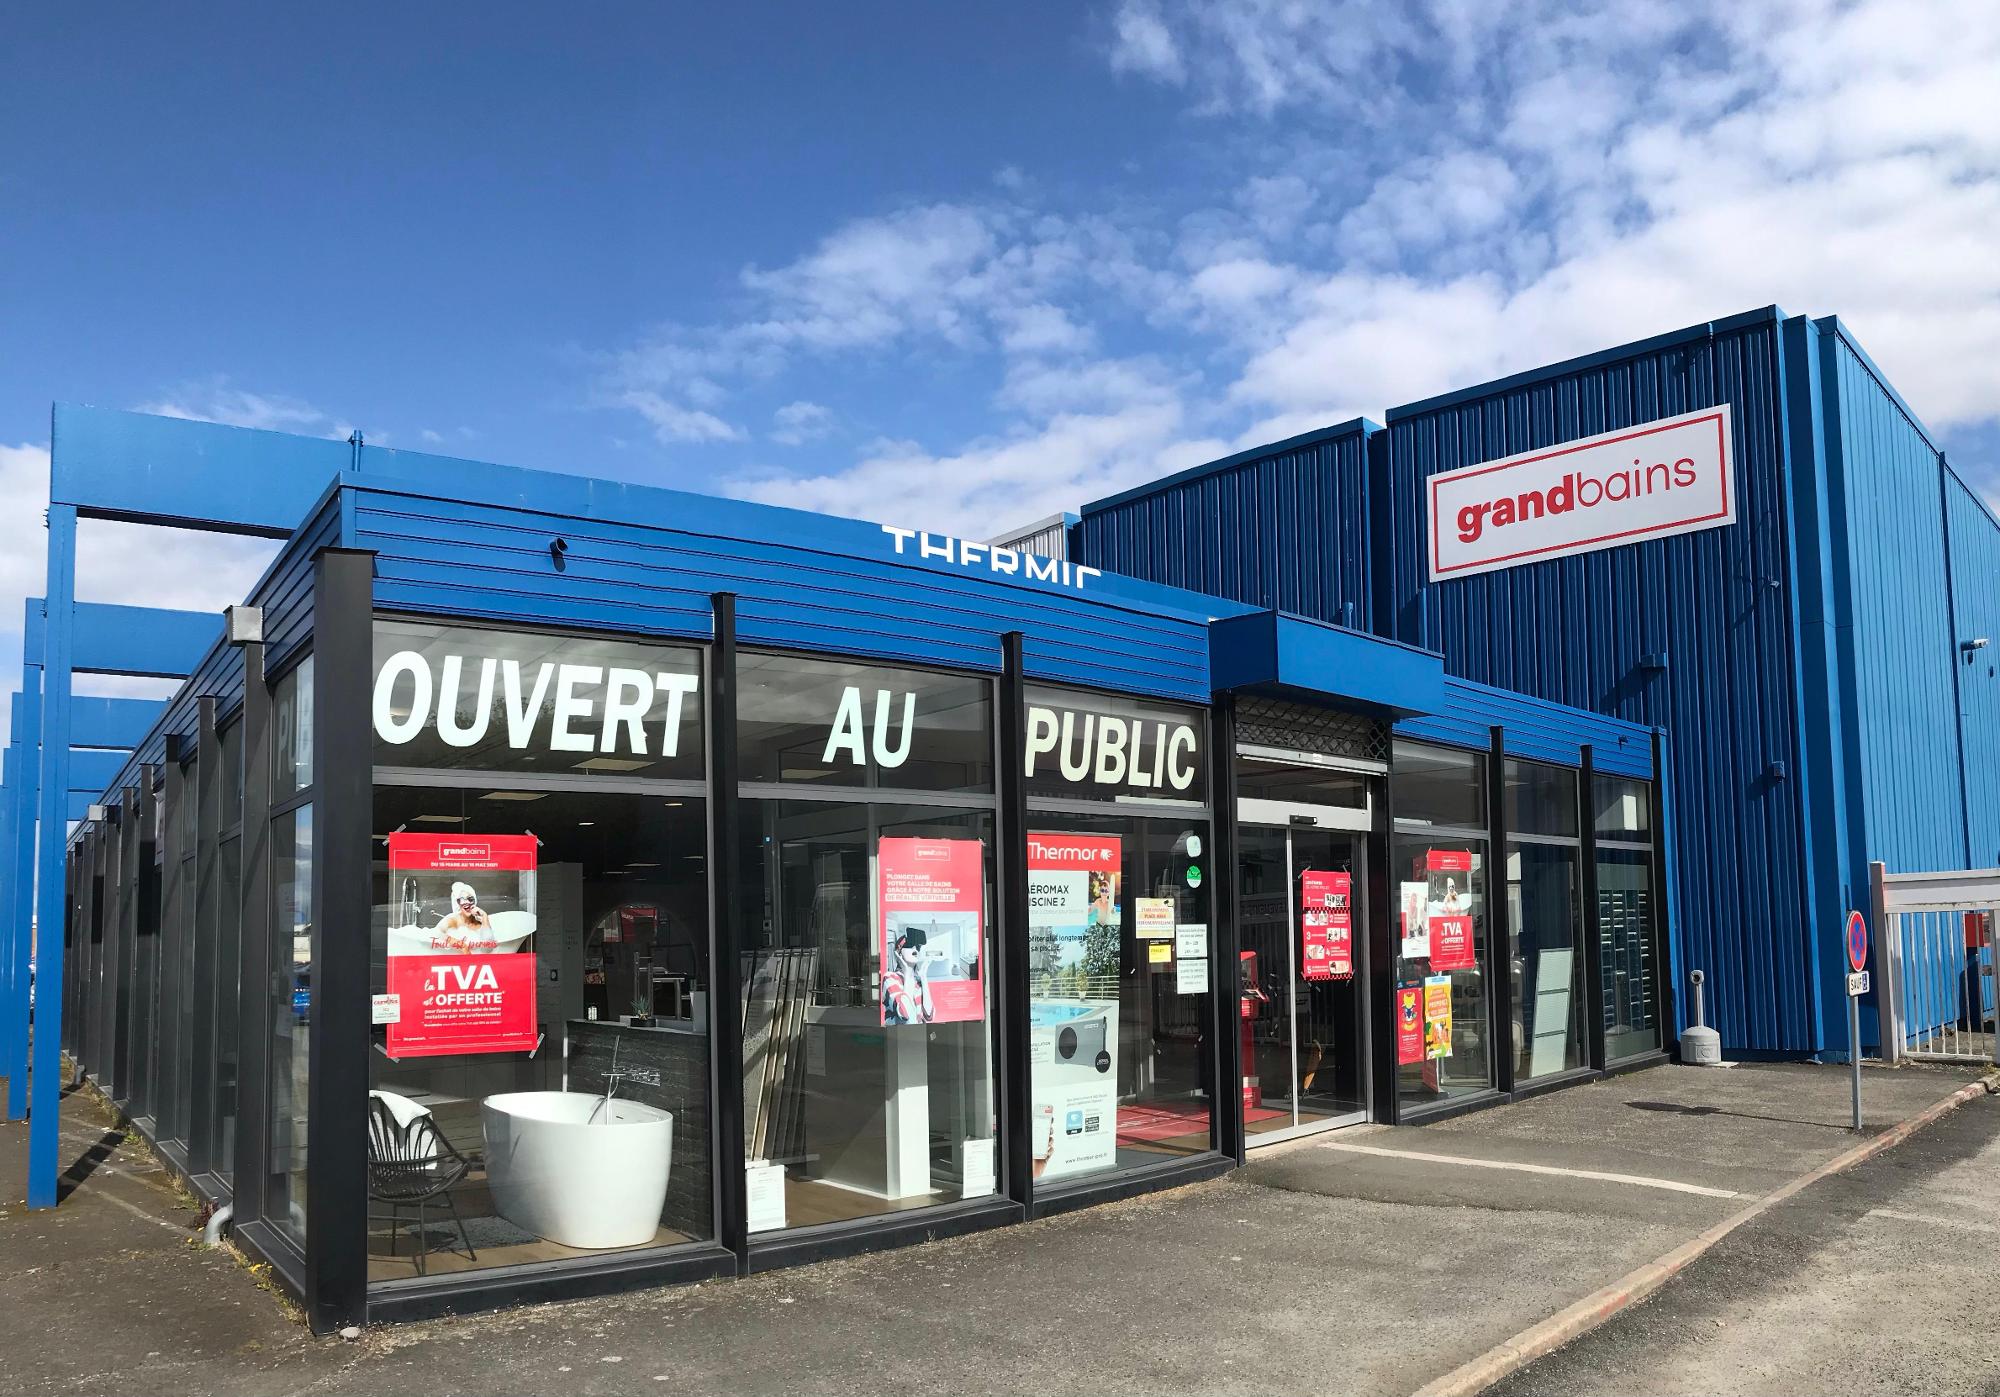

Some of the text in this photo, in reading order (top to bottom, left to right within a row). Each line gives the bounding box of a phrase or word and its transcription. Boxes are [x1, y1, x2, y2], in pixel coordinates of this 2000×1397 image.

[1457, 457, 1697, 543] grandbains
[372, 650, 1197, 790] OUVERT AU PUBLIC
[443, 847, 486, 856] grandbains
[1028, 842, 1098, 861] Thermor
[1028, 884, 1069, 895] ÉROMAX
[1060, 897, 1066, 907] 2
[1307, 896, 1311, 905] 1
[1329, 914, 1333, 923] 2
[1443, 921, 1463, 936] TVA
[1306, 931, 1311, 940] 3
[452, 936, 465, 950] est
[1326, 948, 1330, 956] 4
[1307, 965, 1311, 974] 5
[431, 964, 499, 991] TVA
[1850, 976, 1862, 991] SAUF
